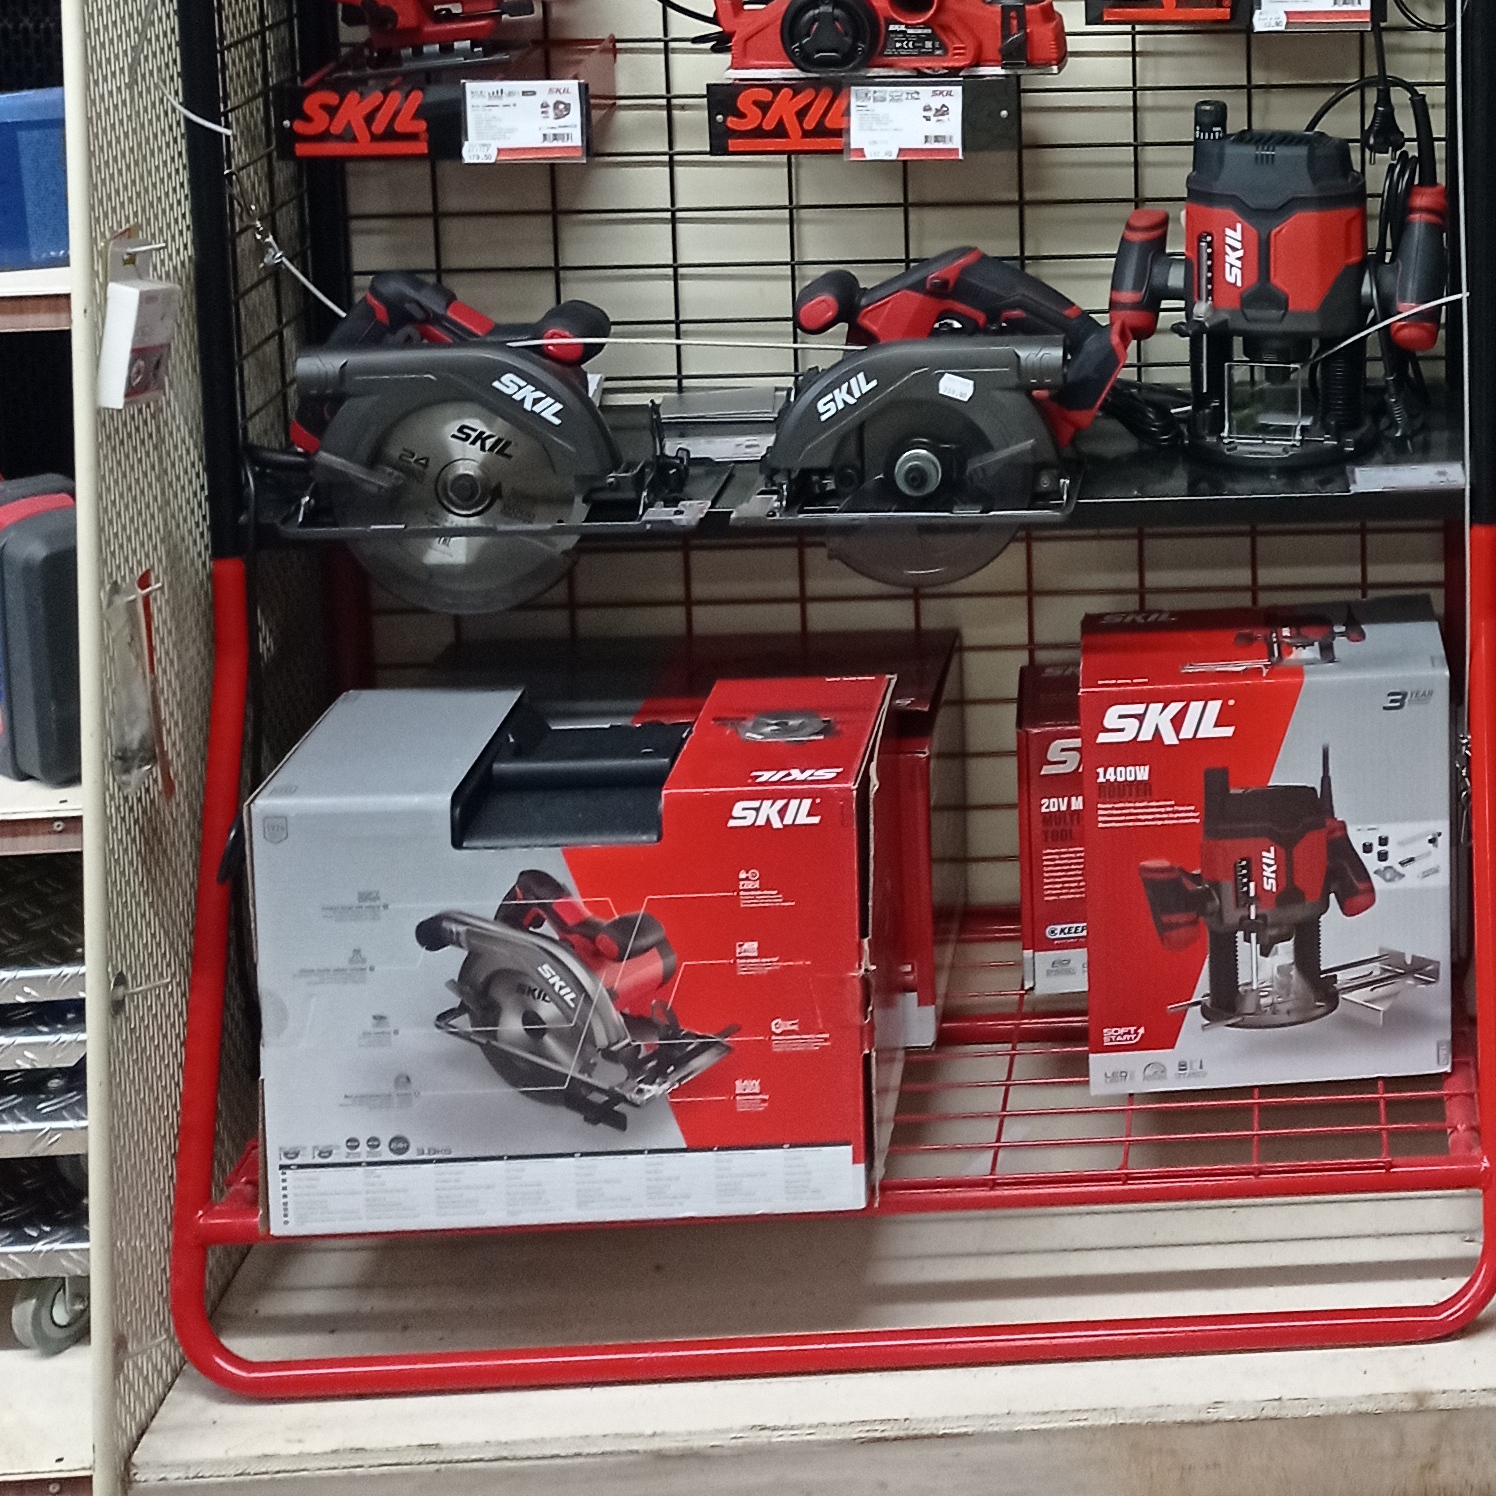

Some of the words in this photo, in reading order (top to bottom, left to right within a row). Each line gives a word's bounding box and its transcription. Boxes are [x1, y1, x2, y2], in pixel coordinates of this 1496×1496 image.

[548, 87, 571, 95] SKIL
[931, 89, 954, 97] SKIL
[294, 90, 428, 143] SKIL
[1225, 222, 1243, 287] SKIL
[492, 372, 564, 426] SKIL
[816, 371, 879, 422] SKIL
[450, 423, 514, 459] SKIL
[1383, 690, 1408, 711] 3
[1410, 689, 1434, 699] YEAR
[1095, 699, 1235, 746] SKIL
[751, 768, 844, 783] SKIL
[1096, 765, 1150, 783] 1400W
[727, 798, 822, 829] SKIL
[1041, 797, 1068, 813] 20V
[1262, 846, 1277, 892] SKIL
[538, 963, 575, 1007] SKIL
